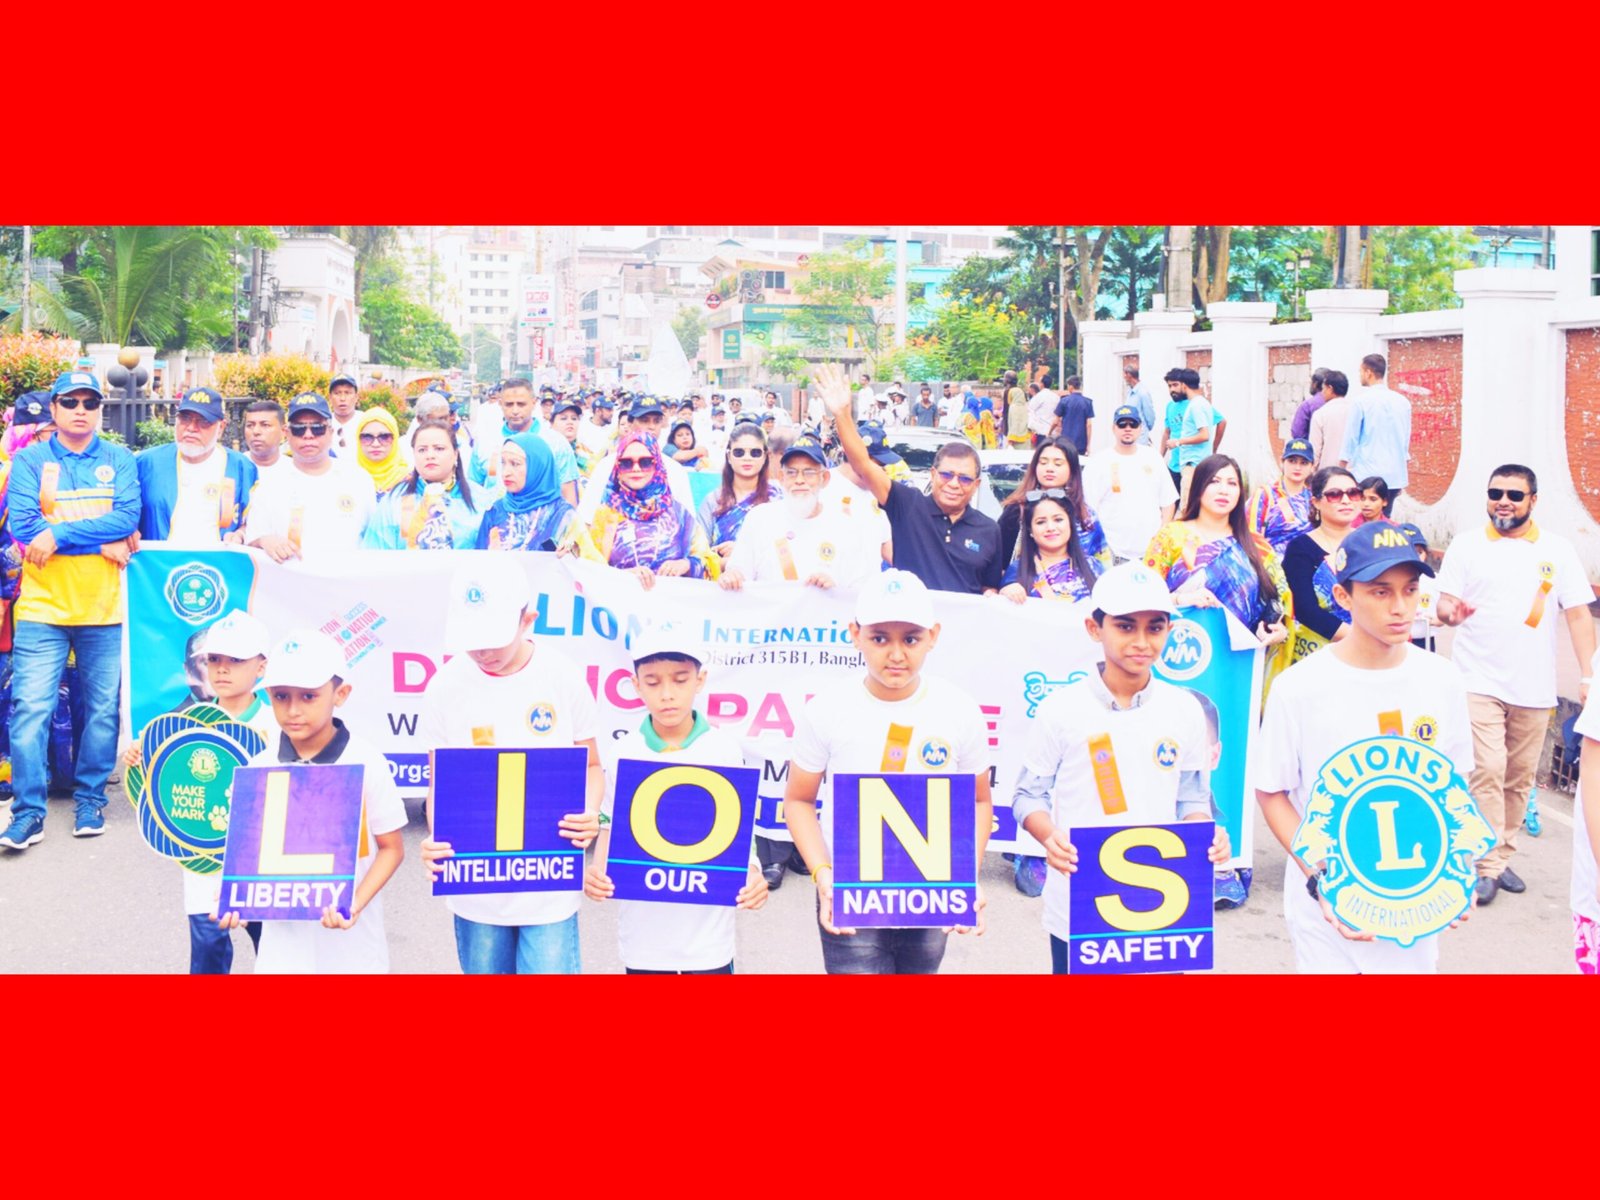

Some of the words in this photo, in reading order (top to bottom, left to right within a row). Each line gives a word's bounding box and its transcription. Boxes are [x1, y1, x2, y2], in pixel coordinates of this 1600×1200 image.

[819, 651, 867, 668] Bangl
[1330, 744, 1443, 789] LIONS
[171, 783, 206, 798] MAKE
[171, 794, 206, 810] YOUR
[495, 751, 527, 852] I
[170, 806, 206, 822] MARK
[257, 770, 335, 875] L
[629, 765, 742, 865] O
[858, 777, 952, 883] N
[1368, 800, 1427, 871] L
[442, 856, 575, 884] INTELLIGENCE
[644, 867, 709, 894] OUR
[1094, 826, 1191, 932] S
[228, 881, 347, 909] LIBERTY
[842, 888, 968, 915] NATIONS
[1345, 889, 1458, 929] INTERNATIONAL
[1078, 934, 1205, 966] SAFETY
